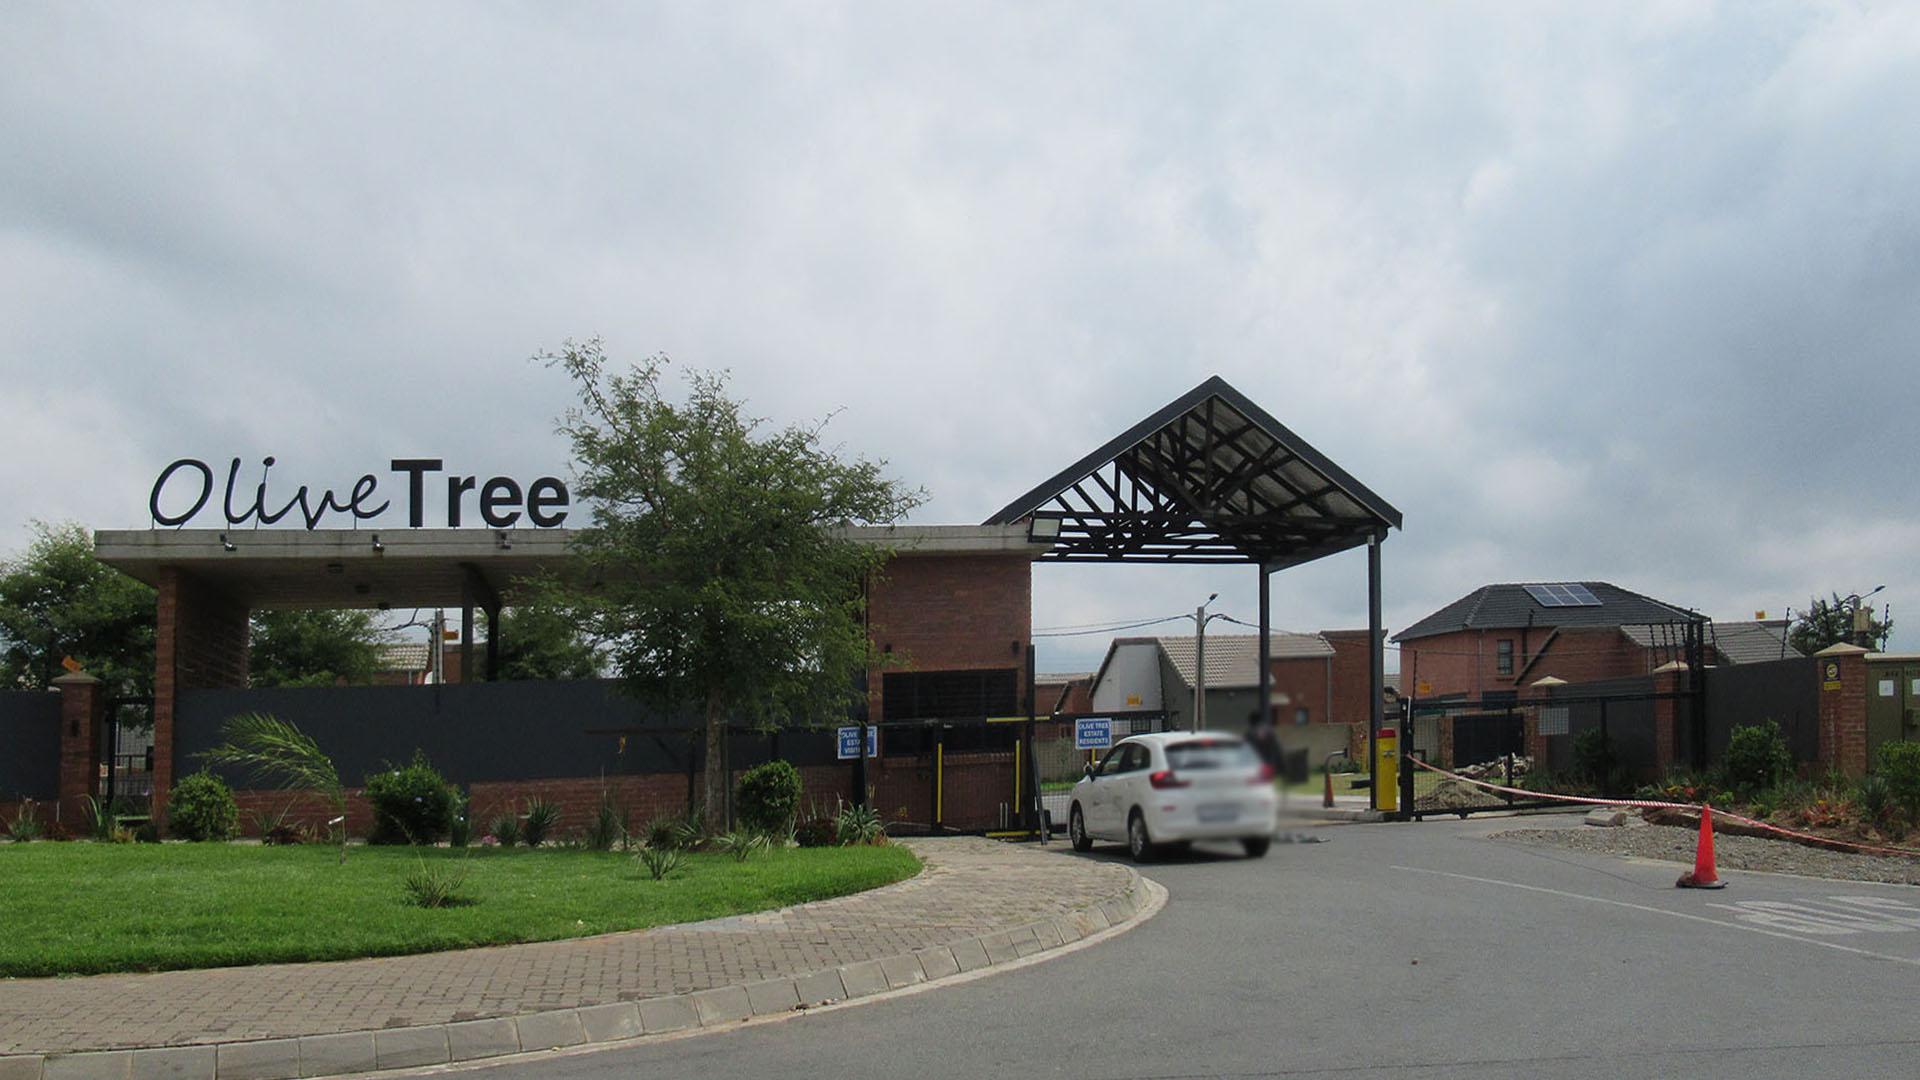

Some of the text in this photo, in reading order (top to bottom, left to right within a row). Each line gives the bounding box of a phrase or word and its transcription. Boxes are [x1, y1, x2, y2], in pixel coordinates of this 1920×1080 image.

[150, 456, 569, 531] Olive Tree
[1095, 721, 1110, 729] TREE
[1079, 737, 1109, 745] RESIDENTS
